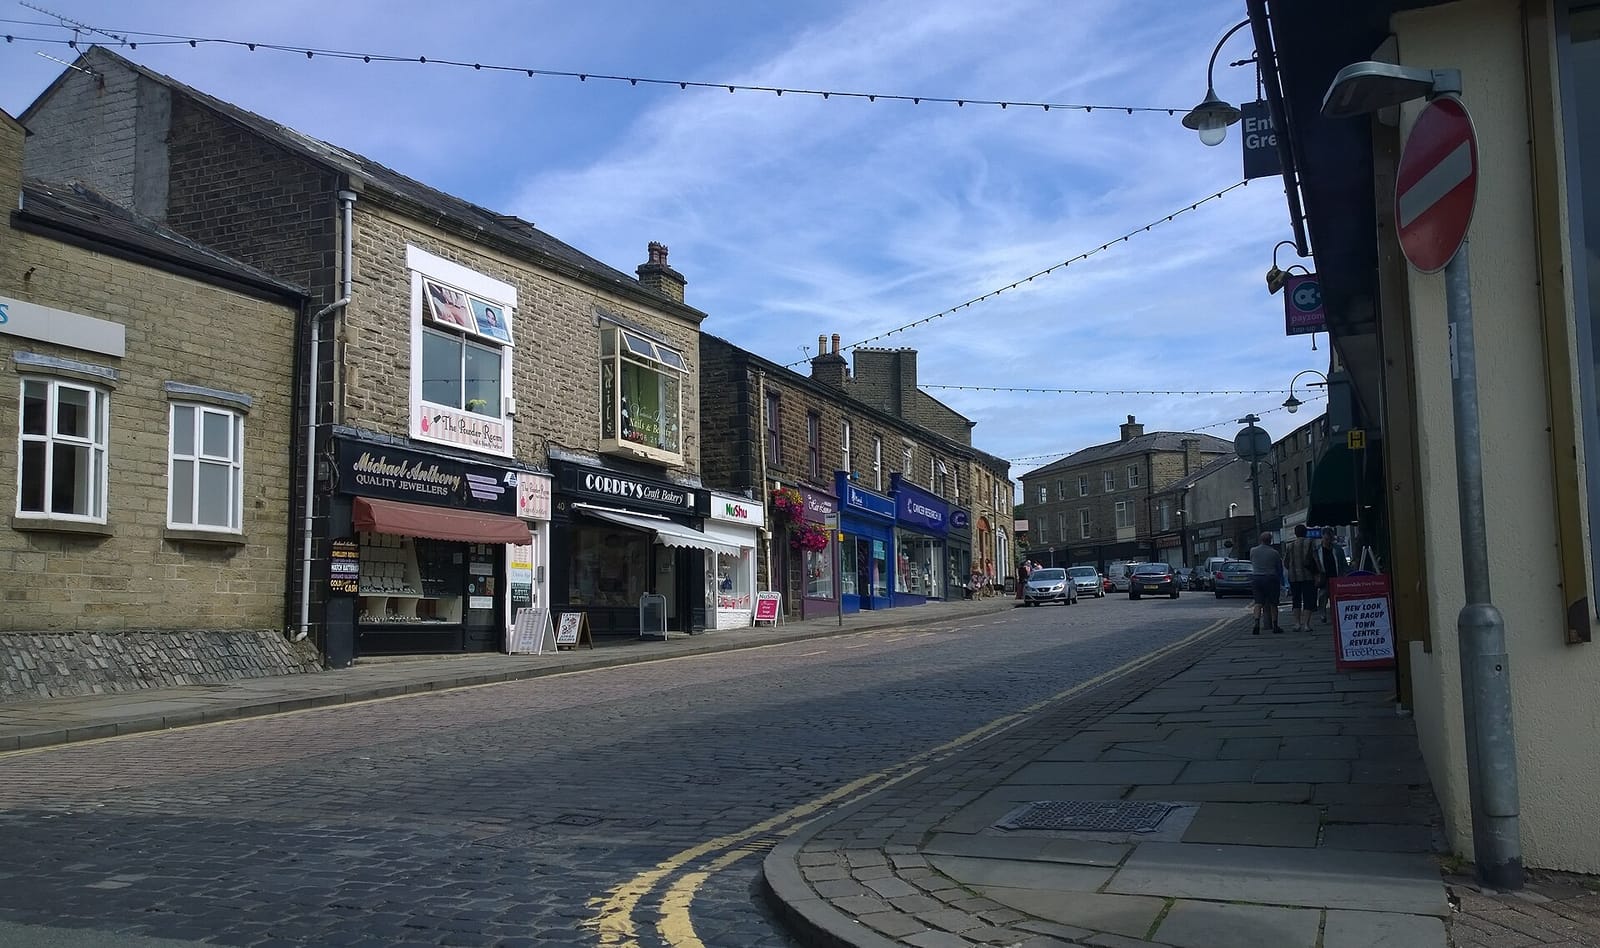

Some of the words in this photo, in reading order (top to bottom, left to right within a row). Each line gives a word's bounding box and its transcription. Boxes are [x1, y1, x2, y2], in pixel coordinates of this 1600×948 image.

[1291, 312, 1325, 323] payzon
[442, 415, 457, 432] The
[482, 424, 503, 442] Room
[1350, 431, 1363, 447] H
[353, 452, 407, 477] Michael
[406, 461, 461, 491] Anthony
[356, 474, 397, 489] QUALITY
[398, 480, 448, 495] JEWELLERS
[585, 473, 643, 499] CORDEYS
[643, 486, 660, 500] Craft
[725, 503, 748, 519] NuShu
[345, 584, 358, 592] CASH
[1344, 604, 1360, 612] NEW
[1344, 613, 1358, 621] FOR
[1360, 611, 1384, 620] BACUP
[1355, 620, 1375, 629] TOWN
[1352, 628, 1380, 637] CENTRE
[1349, 637, 1386, 646] REVEALED
